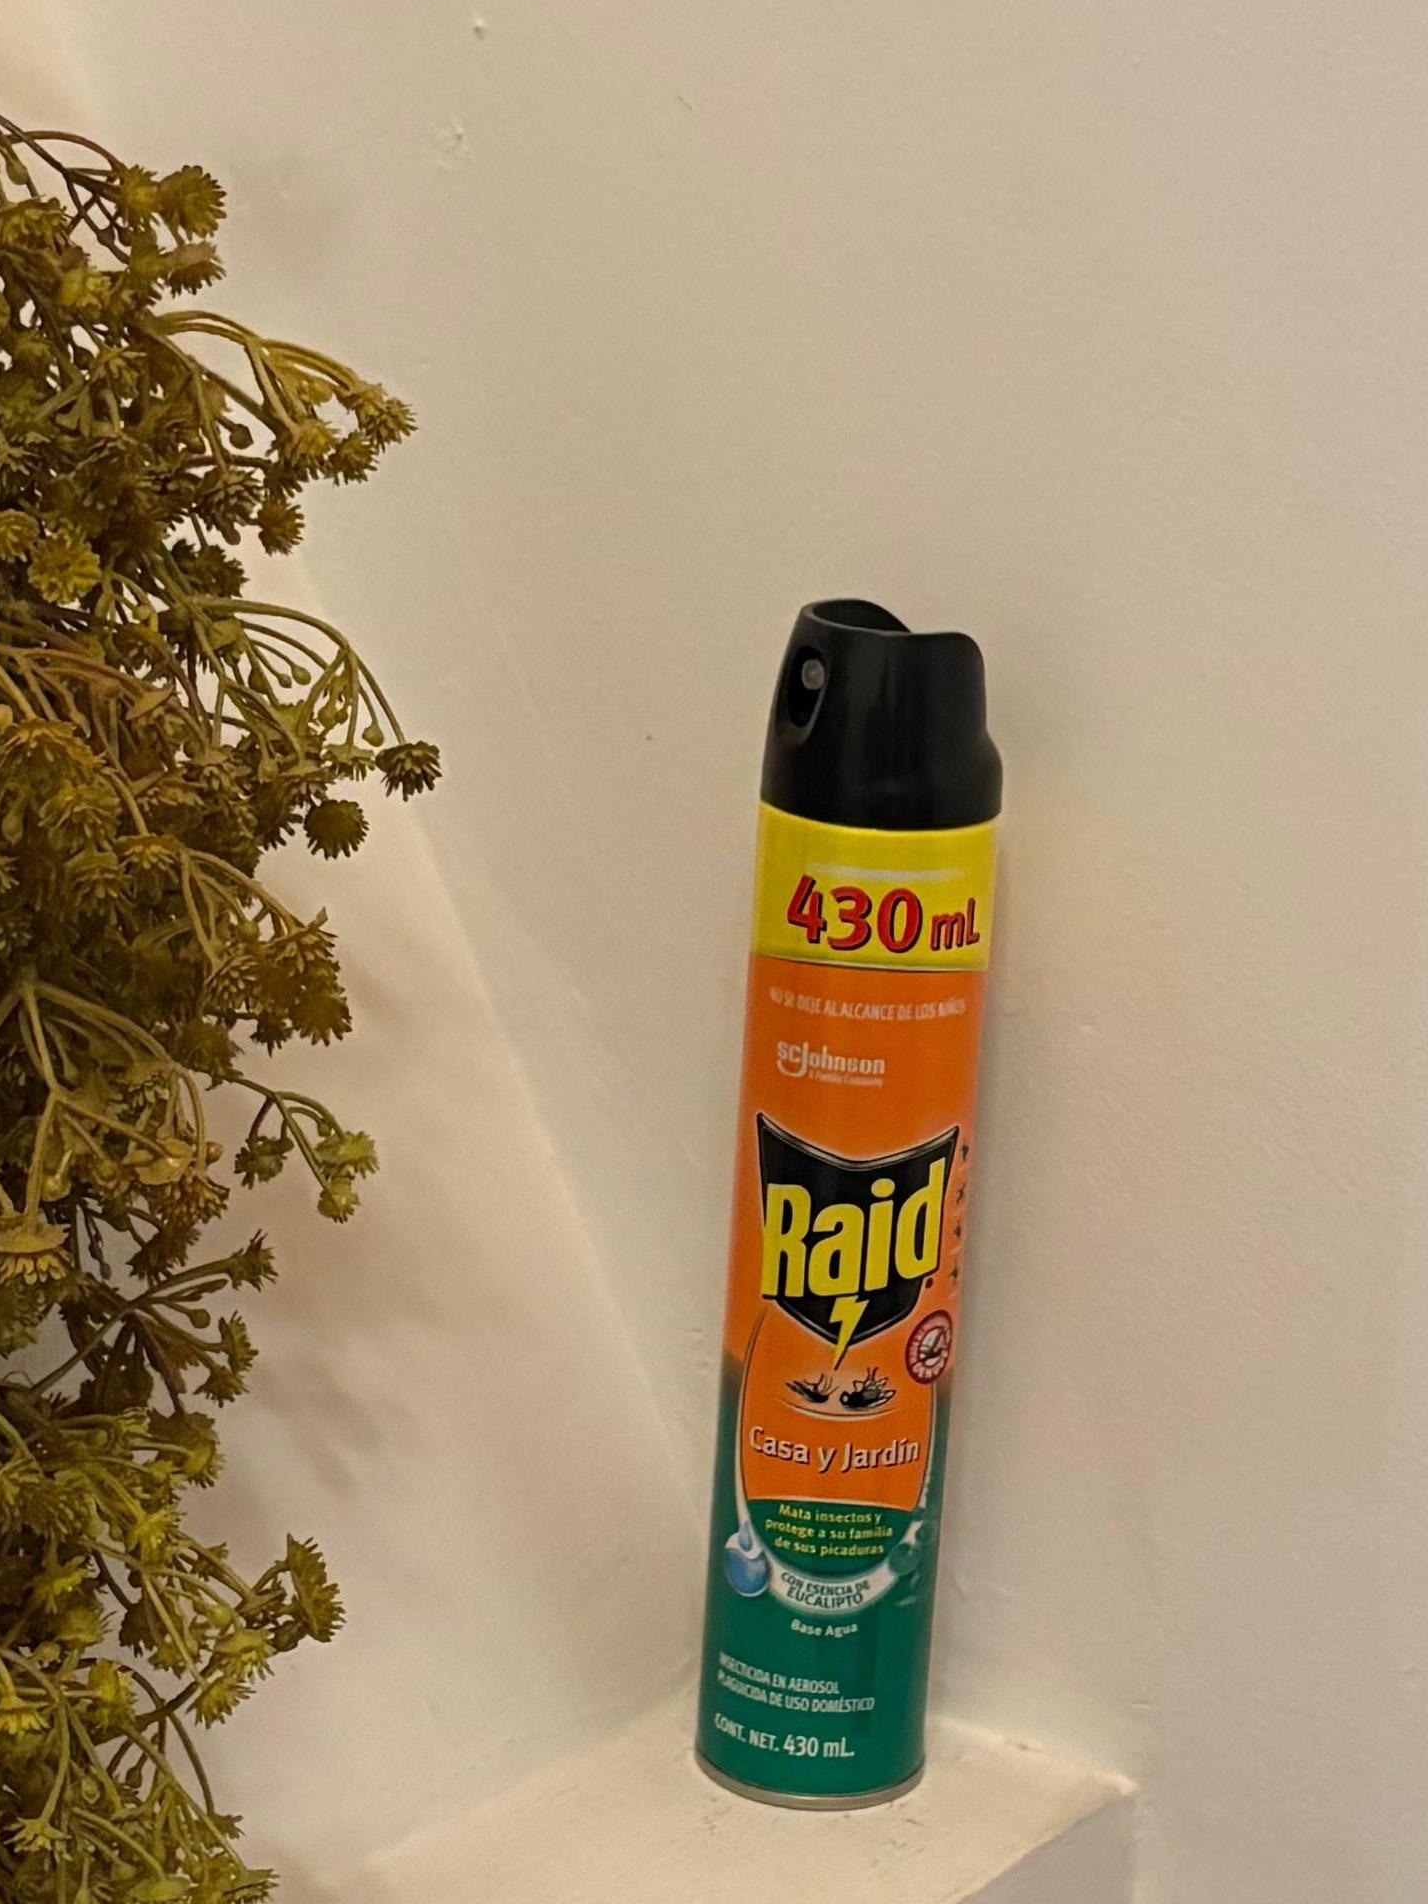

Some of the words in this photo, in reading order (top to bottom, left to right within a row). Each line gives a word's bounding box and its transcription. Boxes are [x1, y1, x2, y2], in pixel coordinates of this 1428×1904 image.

[787, 874, 923, 954] 430
[930, 897, 981, 952] mL
[823, 1000, 838, 1017] AL
[840, 1002, 895, 1021] ALCANCE
[897, 1004, 912, 1021] DE
[915, 1003, 936, 1020] LOS
[761, 1157, 946, 1298] Raid
[748, 1426, 810, 1465] Casa
[818, 1447, 837, 1474] y
[842, 1437, 920, 1474] Jardín
[779, 1503, 811, 1520] Mata
[815, 1509, 871, 1523] insectos
[874, 1513, 882, 1525] y
[765, 1519, 815, 1539] protege
[818, 1529, 826, 1538] a
[830, 1529, 846, 1539] su
[849, 1526, 893, 1540] familia
[774, 1536, 791, 1549] de
[794, 1542, 816, 1554] sus
[820, 1543, 884, 1556] picaduras
[780, 1572, 804, 1589] CON
[807, 1582, 853, 1595] ESENCIA
[855, 1580, 870, 1592] DE
[787, 1586, 863, 1608] EUCALIPTO
[791, 1619, 822, 1636] Base
[824, 1624, 858, 1638] Agua
[772, 1673, 787, 1689] EN
[788, 1677, 840, 1694] AEROSOL
[769, 1691, 783, 1707] DE
[785, 1695, 809, 1711] USO
[811, 1696, 875, 1713] DOMÉSTICO
[714, 1712, 746, 1742] CONT.
[749, 1729, 779, 1752] NET.
[783, 1734, 819, 1757] 430
